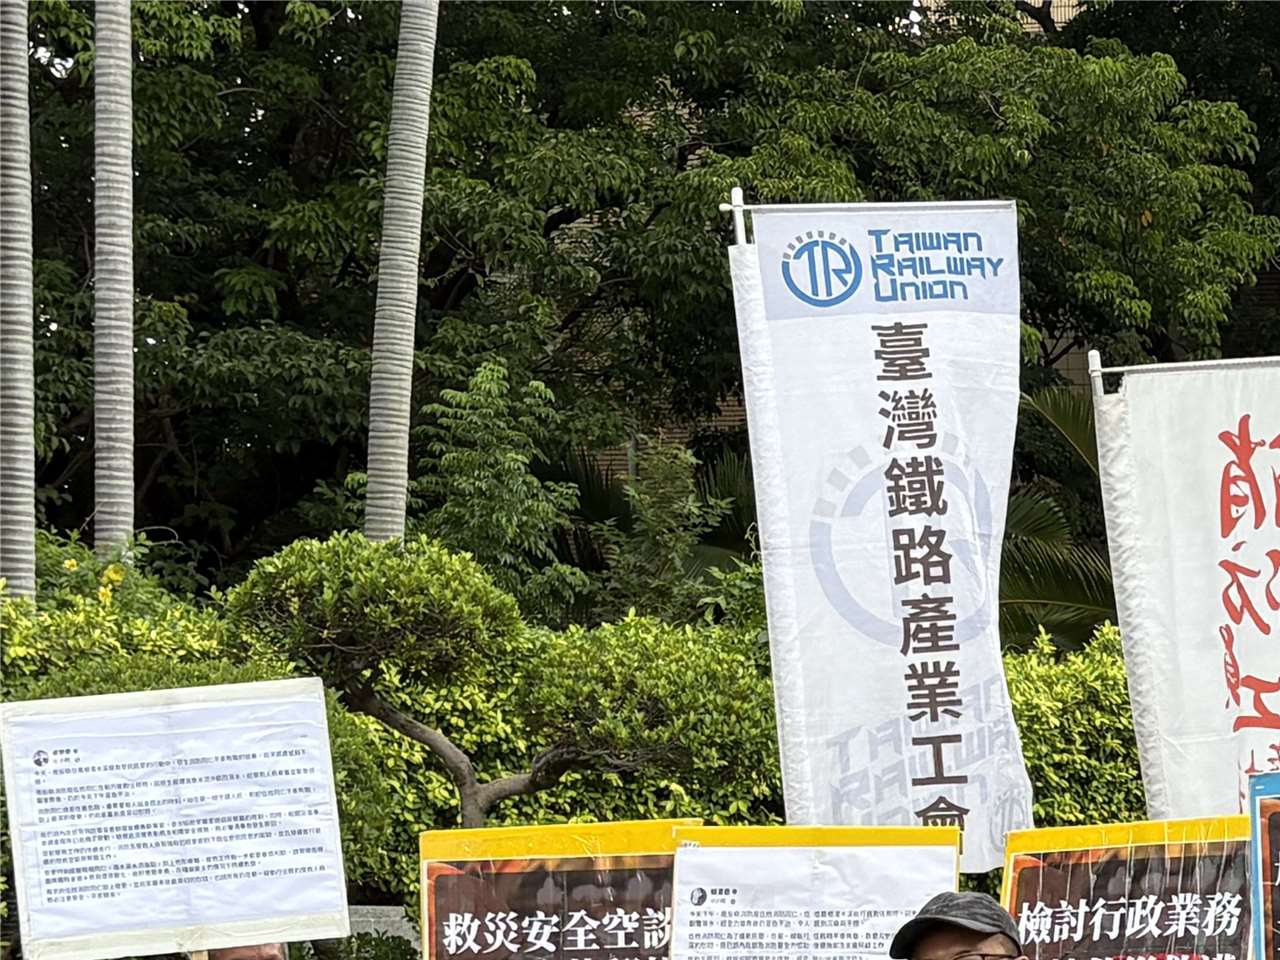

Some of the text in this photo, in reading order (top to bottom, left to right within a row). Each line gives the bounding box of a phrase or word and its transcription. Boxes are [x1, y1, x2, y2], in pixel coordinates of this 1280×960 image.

[870, 254, 1004, 280] RAILWAY
[1018, 891, 1243, 944] 檢討行政業務
